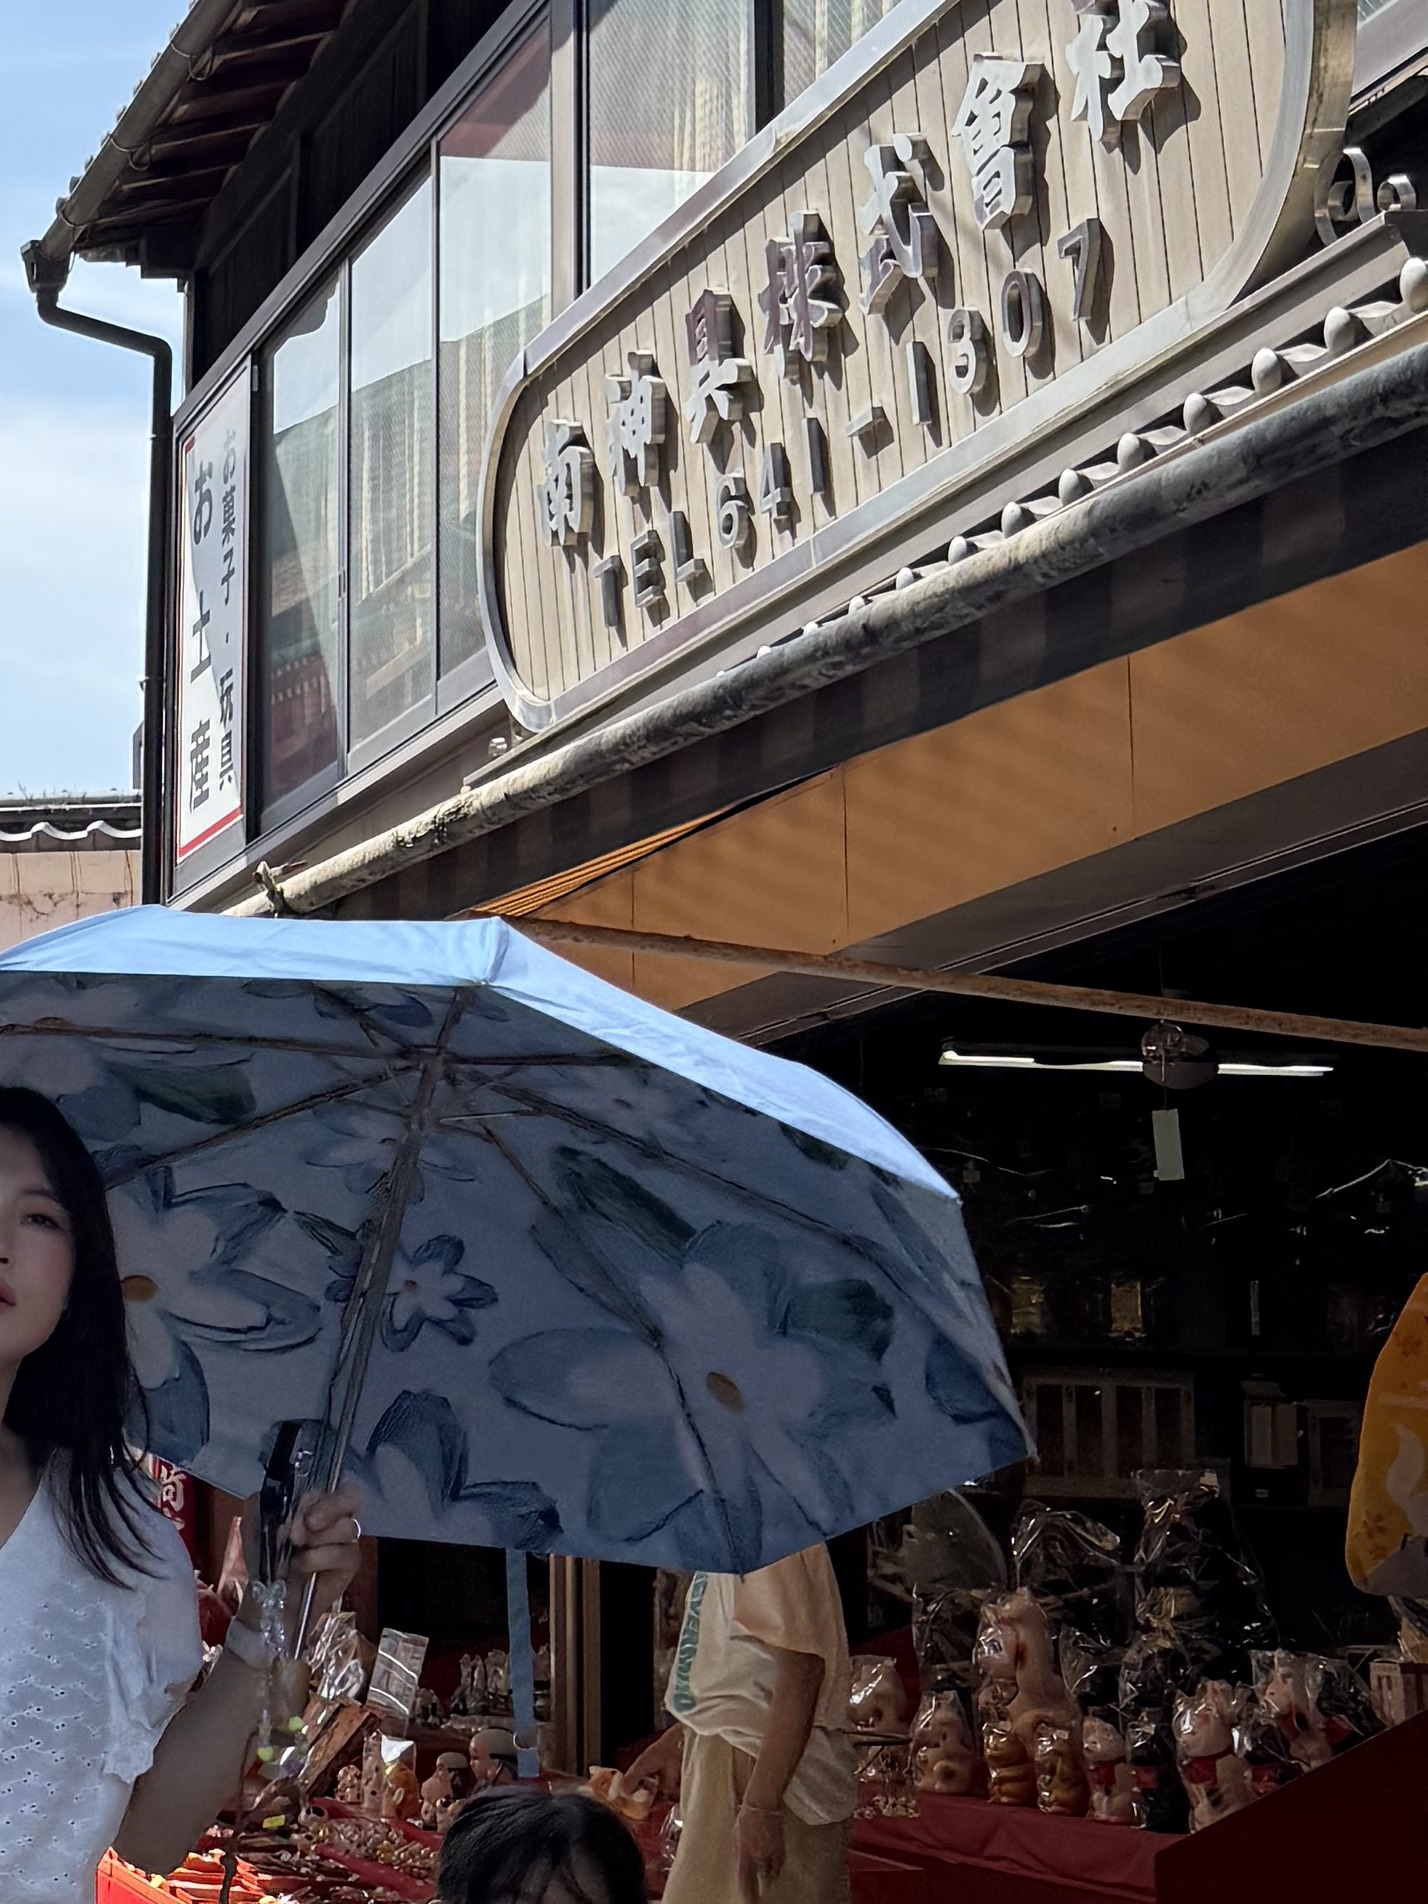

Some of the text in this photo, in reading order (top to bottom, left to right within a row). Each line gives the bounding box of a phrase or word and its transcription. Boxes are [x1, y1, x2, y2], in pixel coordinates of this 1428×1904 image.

[189, 459, 214, 815] お土産
[593, 511, 706, 627] TEL
